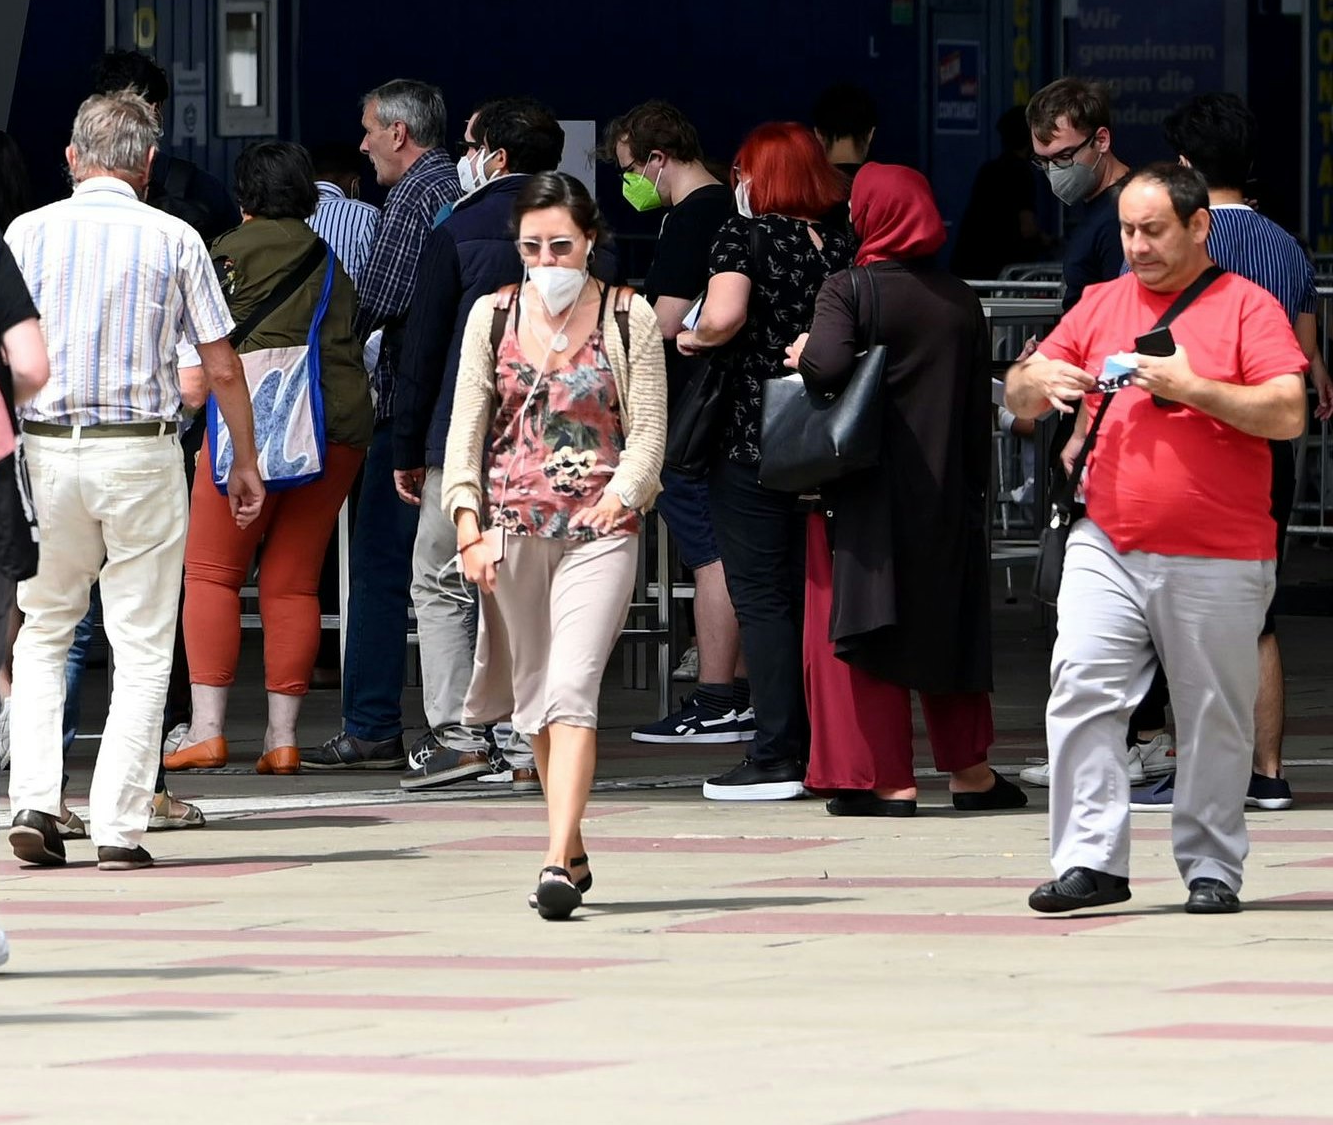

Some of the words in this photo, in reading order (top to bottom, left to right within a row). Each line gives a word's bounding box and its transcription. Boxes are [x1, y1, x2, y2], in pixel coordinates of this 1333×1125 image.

[1077, 6, 1122, 30] Wir
[869, 35, 881, 59] L
[1077, 38, 1216, 67] gemeinsam
